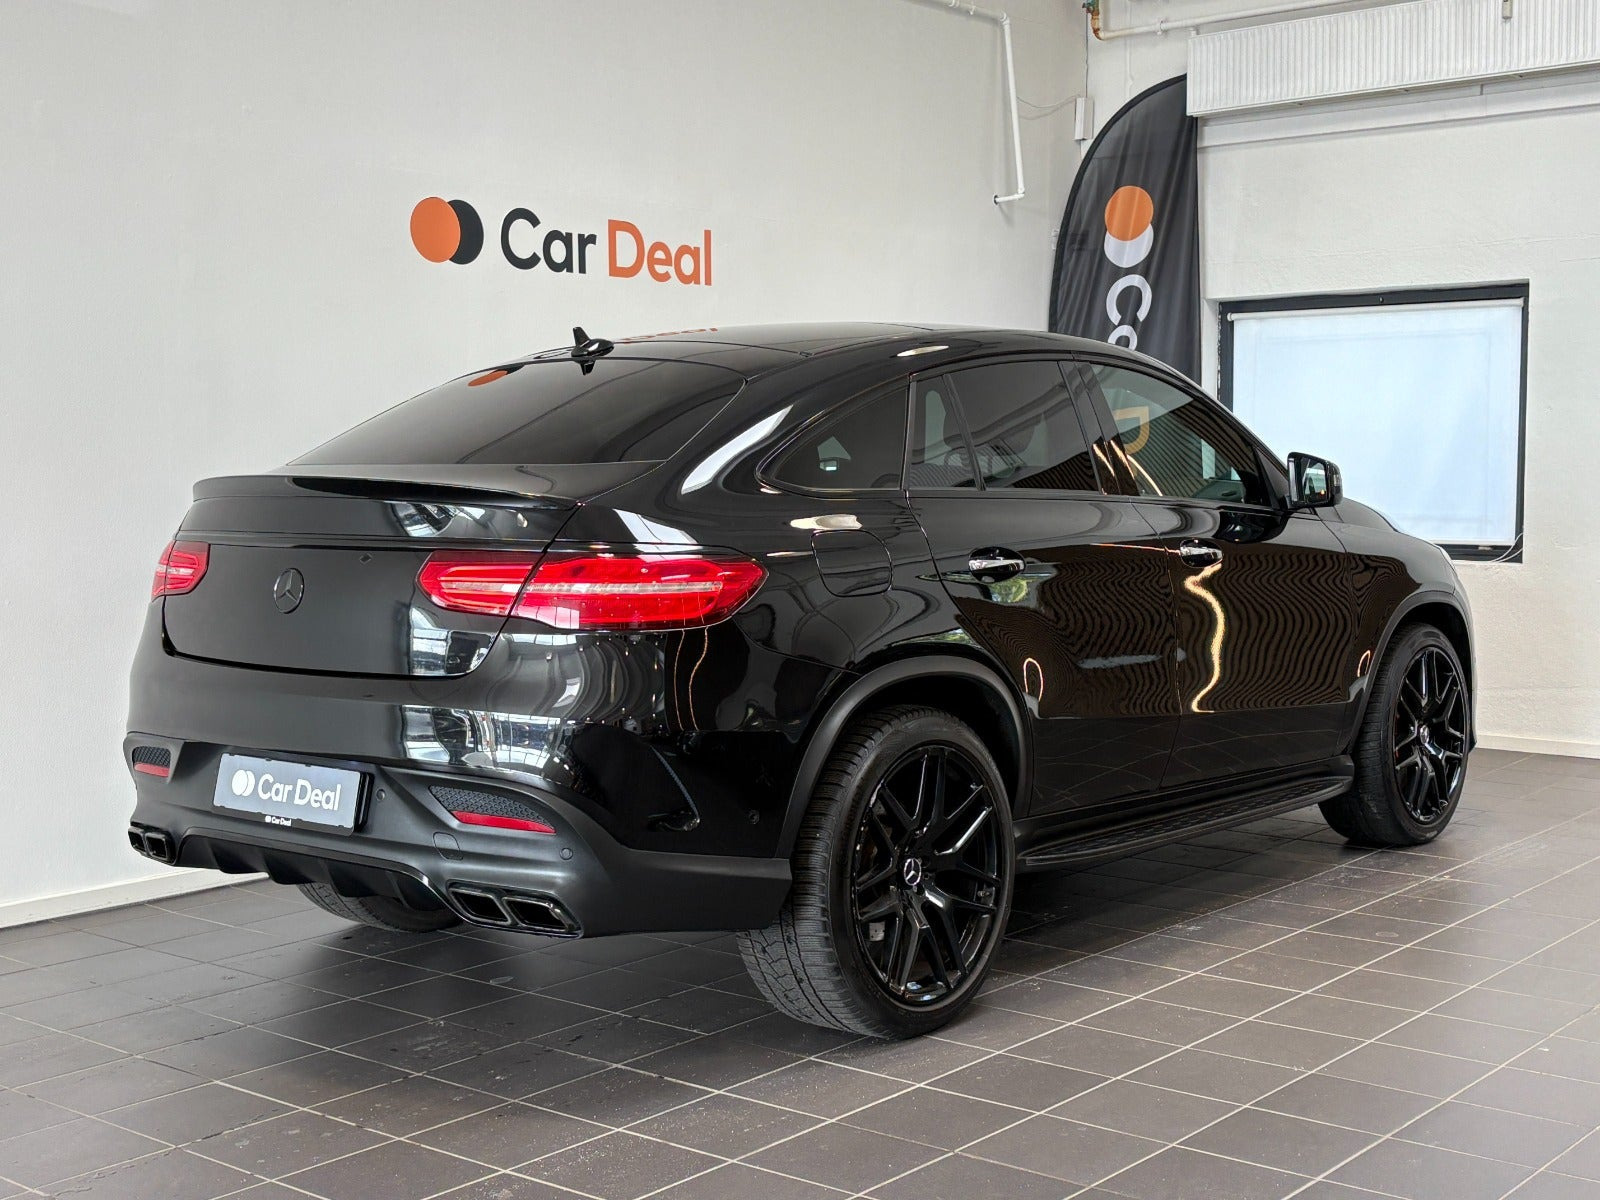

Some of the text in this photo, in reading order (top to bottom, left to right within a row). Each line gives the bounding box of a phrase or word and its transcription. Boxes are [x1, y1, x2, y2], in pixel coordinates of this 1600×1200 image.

[500, 207, 712, 287] Car Deal
[257, 773, 342, 811] Car Deal
